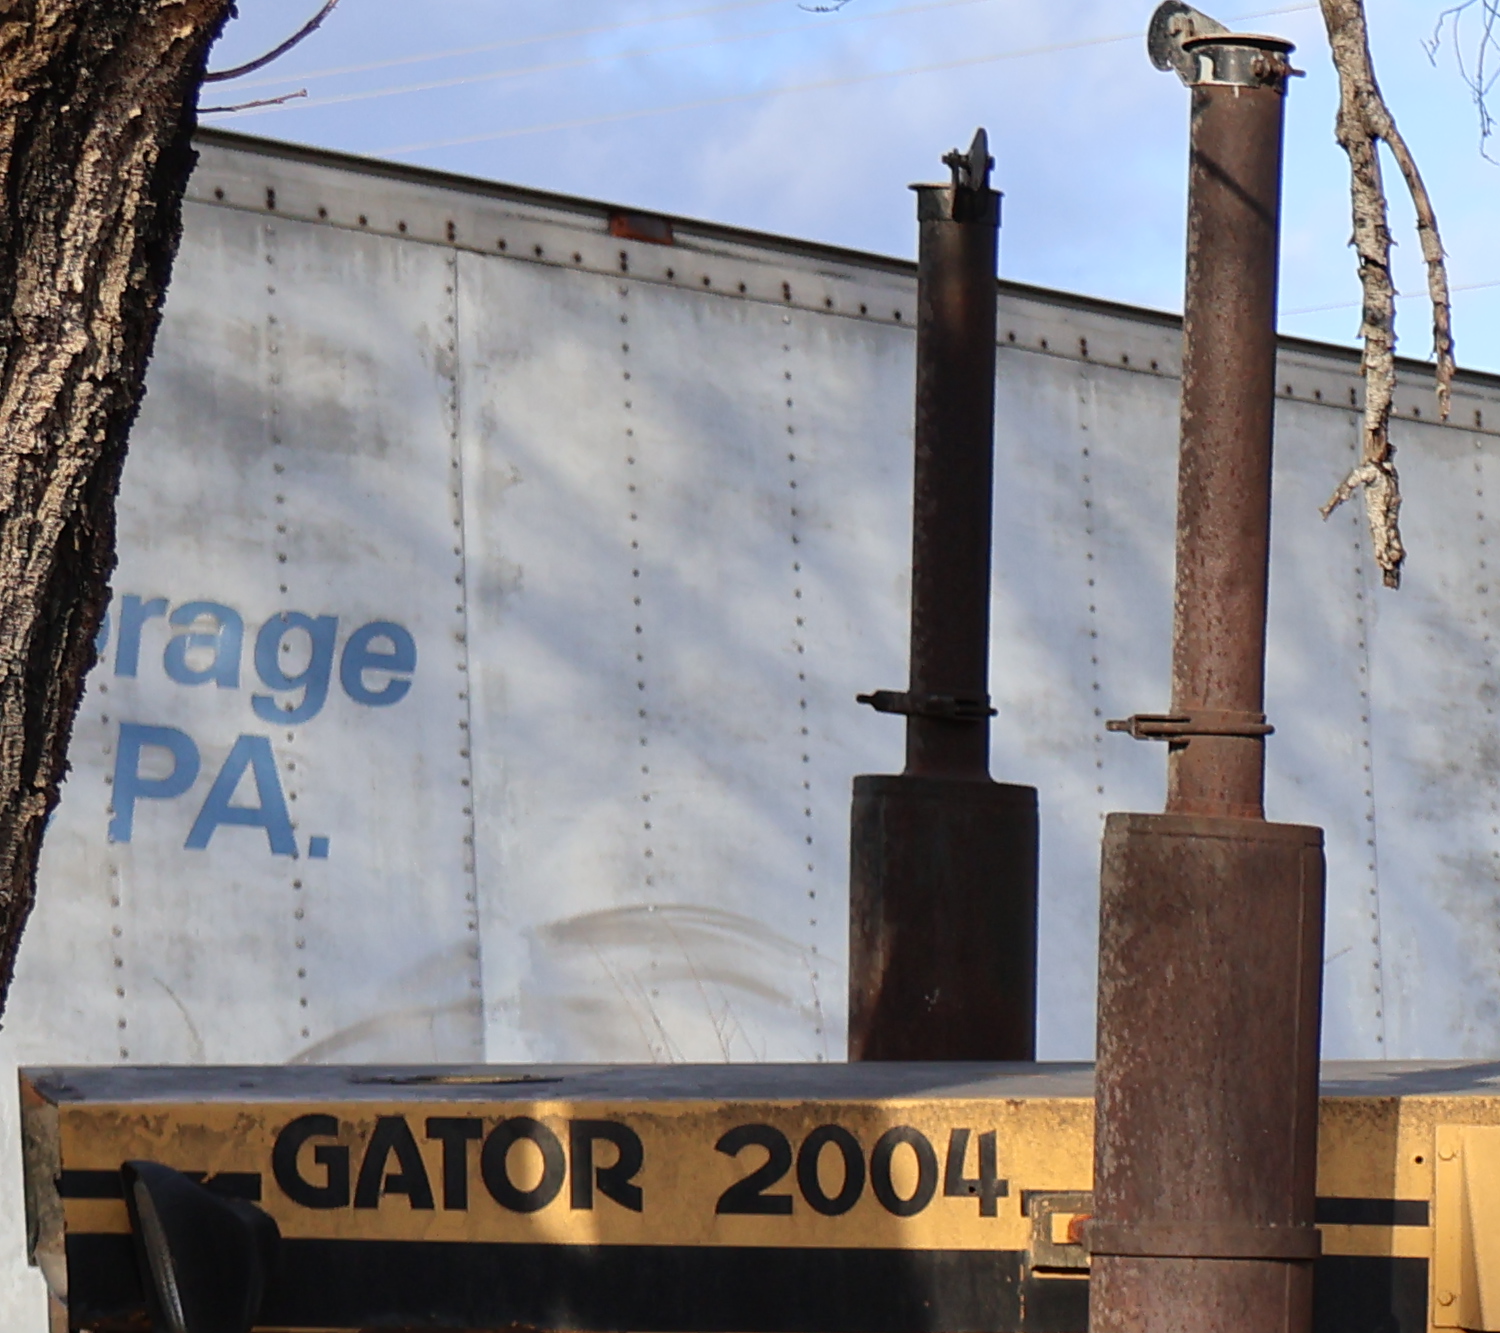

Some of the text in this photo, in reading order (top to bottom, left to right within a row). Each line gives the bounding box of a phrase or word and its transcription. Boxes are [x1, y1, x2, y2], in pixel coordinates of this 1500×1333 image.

[97, 593, 418, 726] rage
[108, 721, 331, 860] PA.
[272, 1112, 1010, 1218] GATOR 2004
